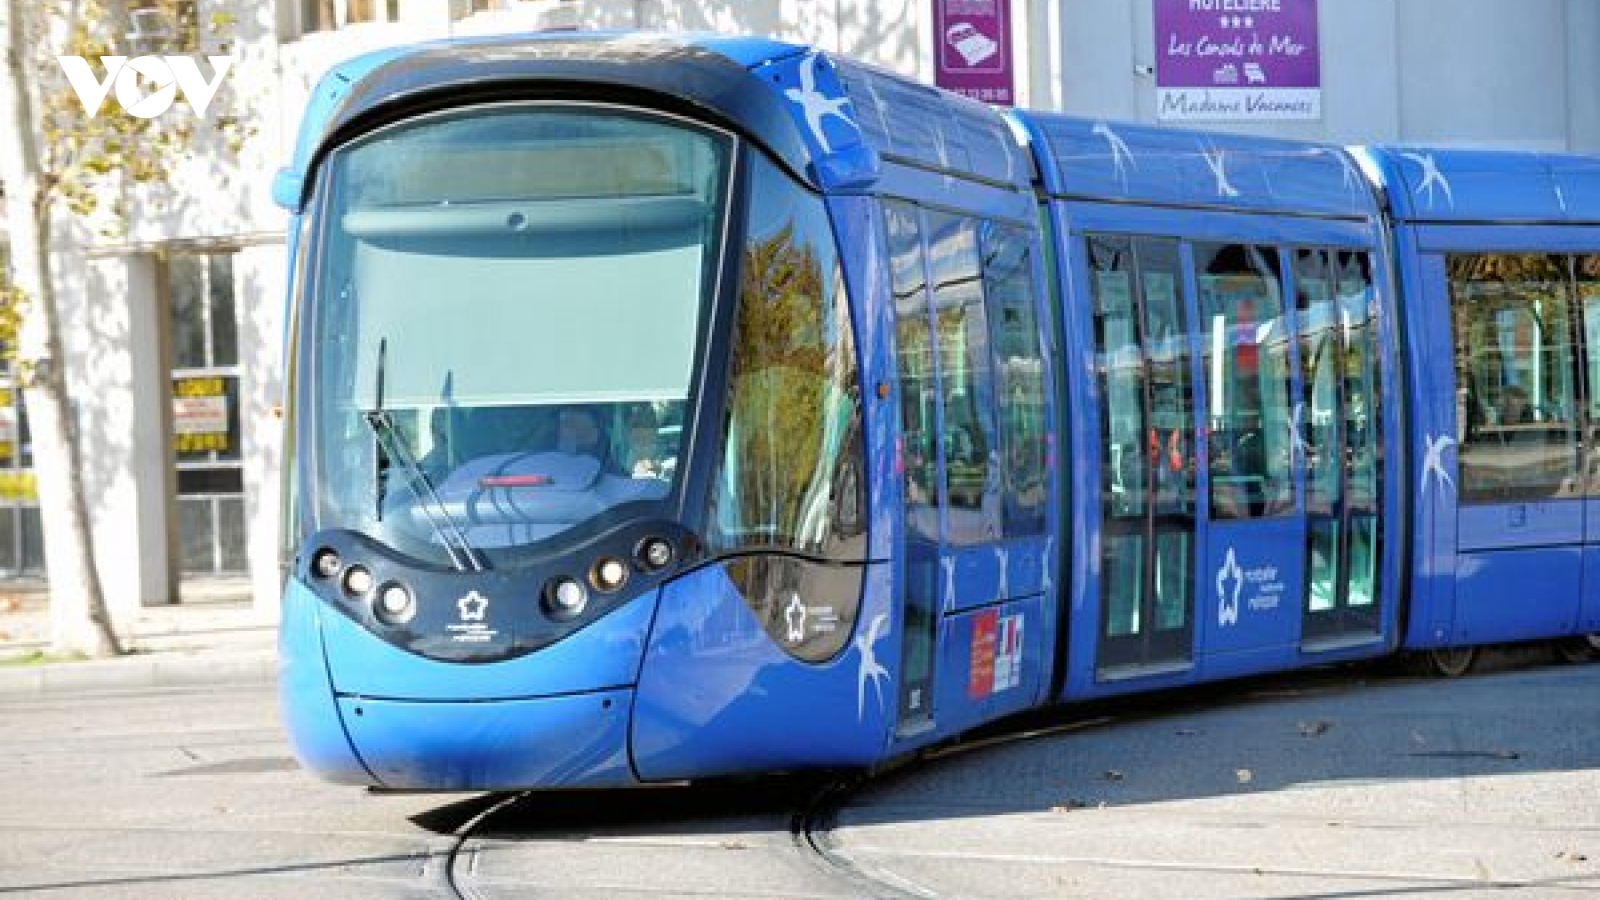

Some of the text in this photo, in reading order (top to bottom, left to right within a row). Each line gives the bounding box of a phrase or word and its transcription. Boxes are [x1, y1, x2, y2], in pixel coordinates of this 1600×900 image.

[1168, 33, 1192, 57] Les
[1247, 33, 1265, 56] de
[1268, 35, 1305, 56] Mer
[1162, 91, 1313, 115] Madame Vacances
